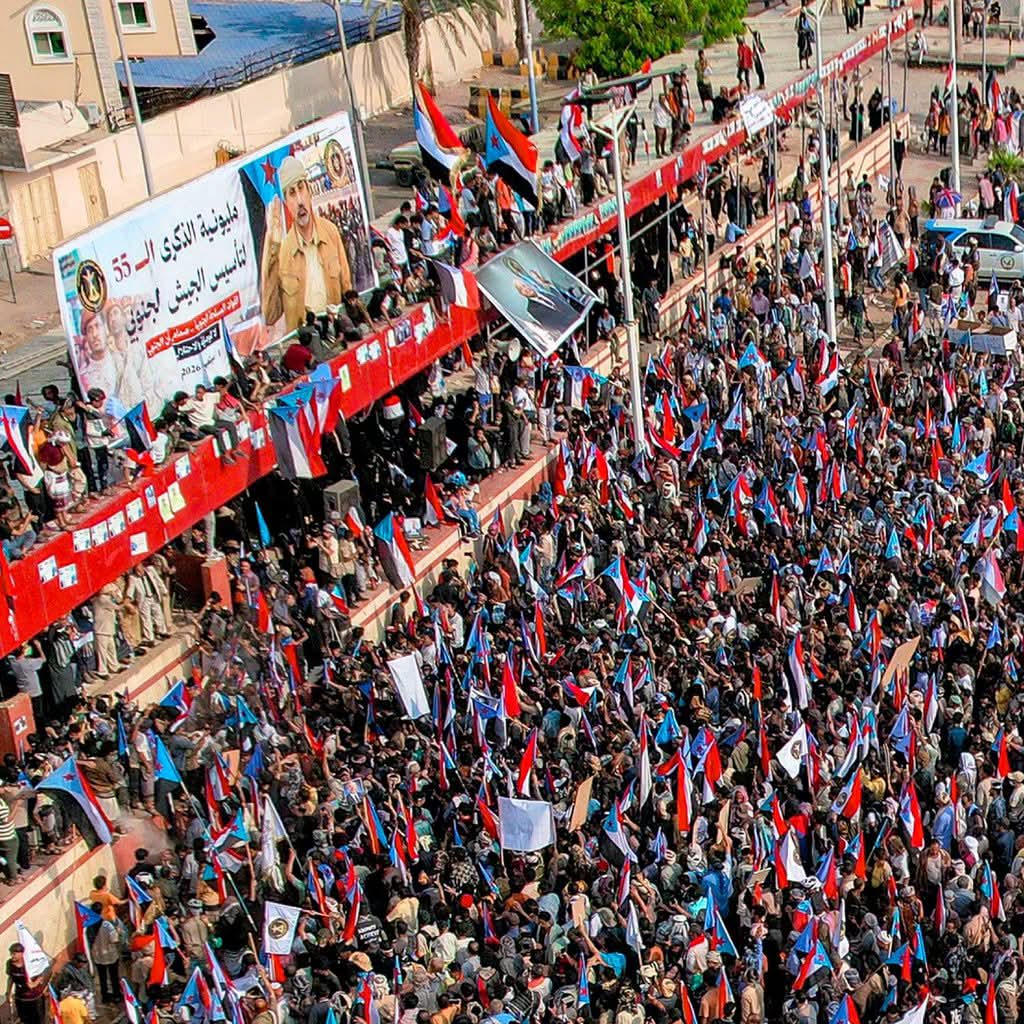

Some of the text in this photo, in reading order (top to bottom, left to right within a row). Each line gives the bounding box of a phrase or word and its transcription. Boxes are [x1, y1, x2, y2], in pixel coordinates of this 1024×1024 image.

[160, 217, 197, 262] الذكرى
[197, 201, 239, 241] مليونية
[111, 252, 132, 282] 55
[168, 266, 207, 314] الجيش
